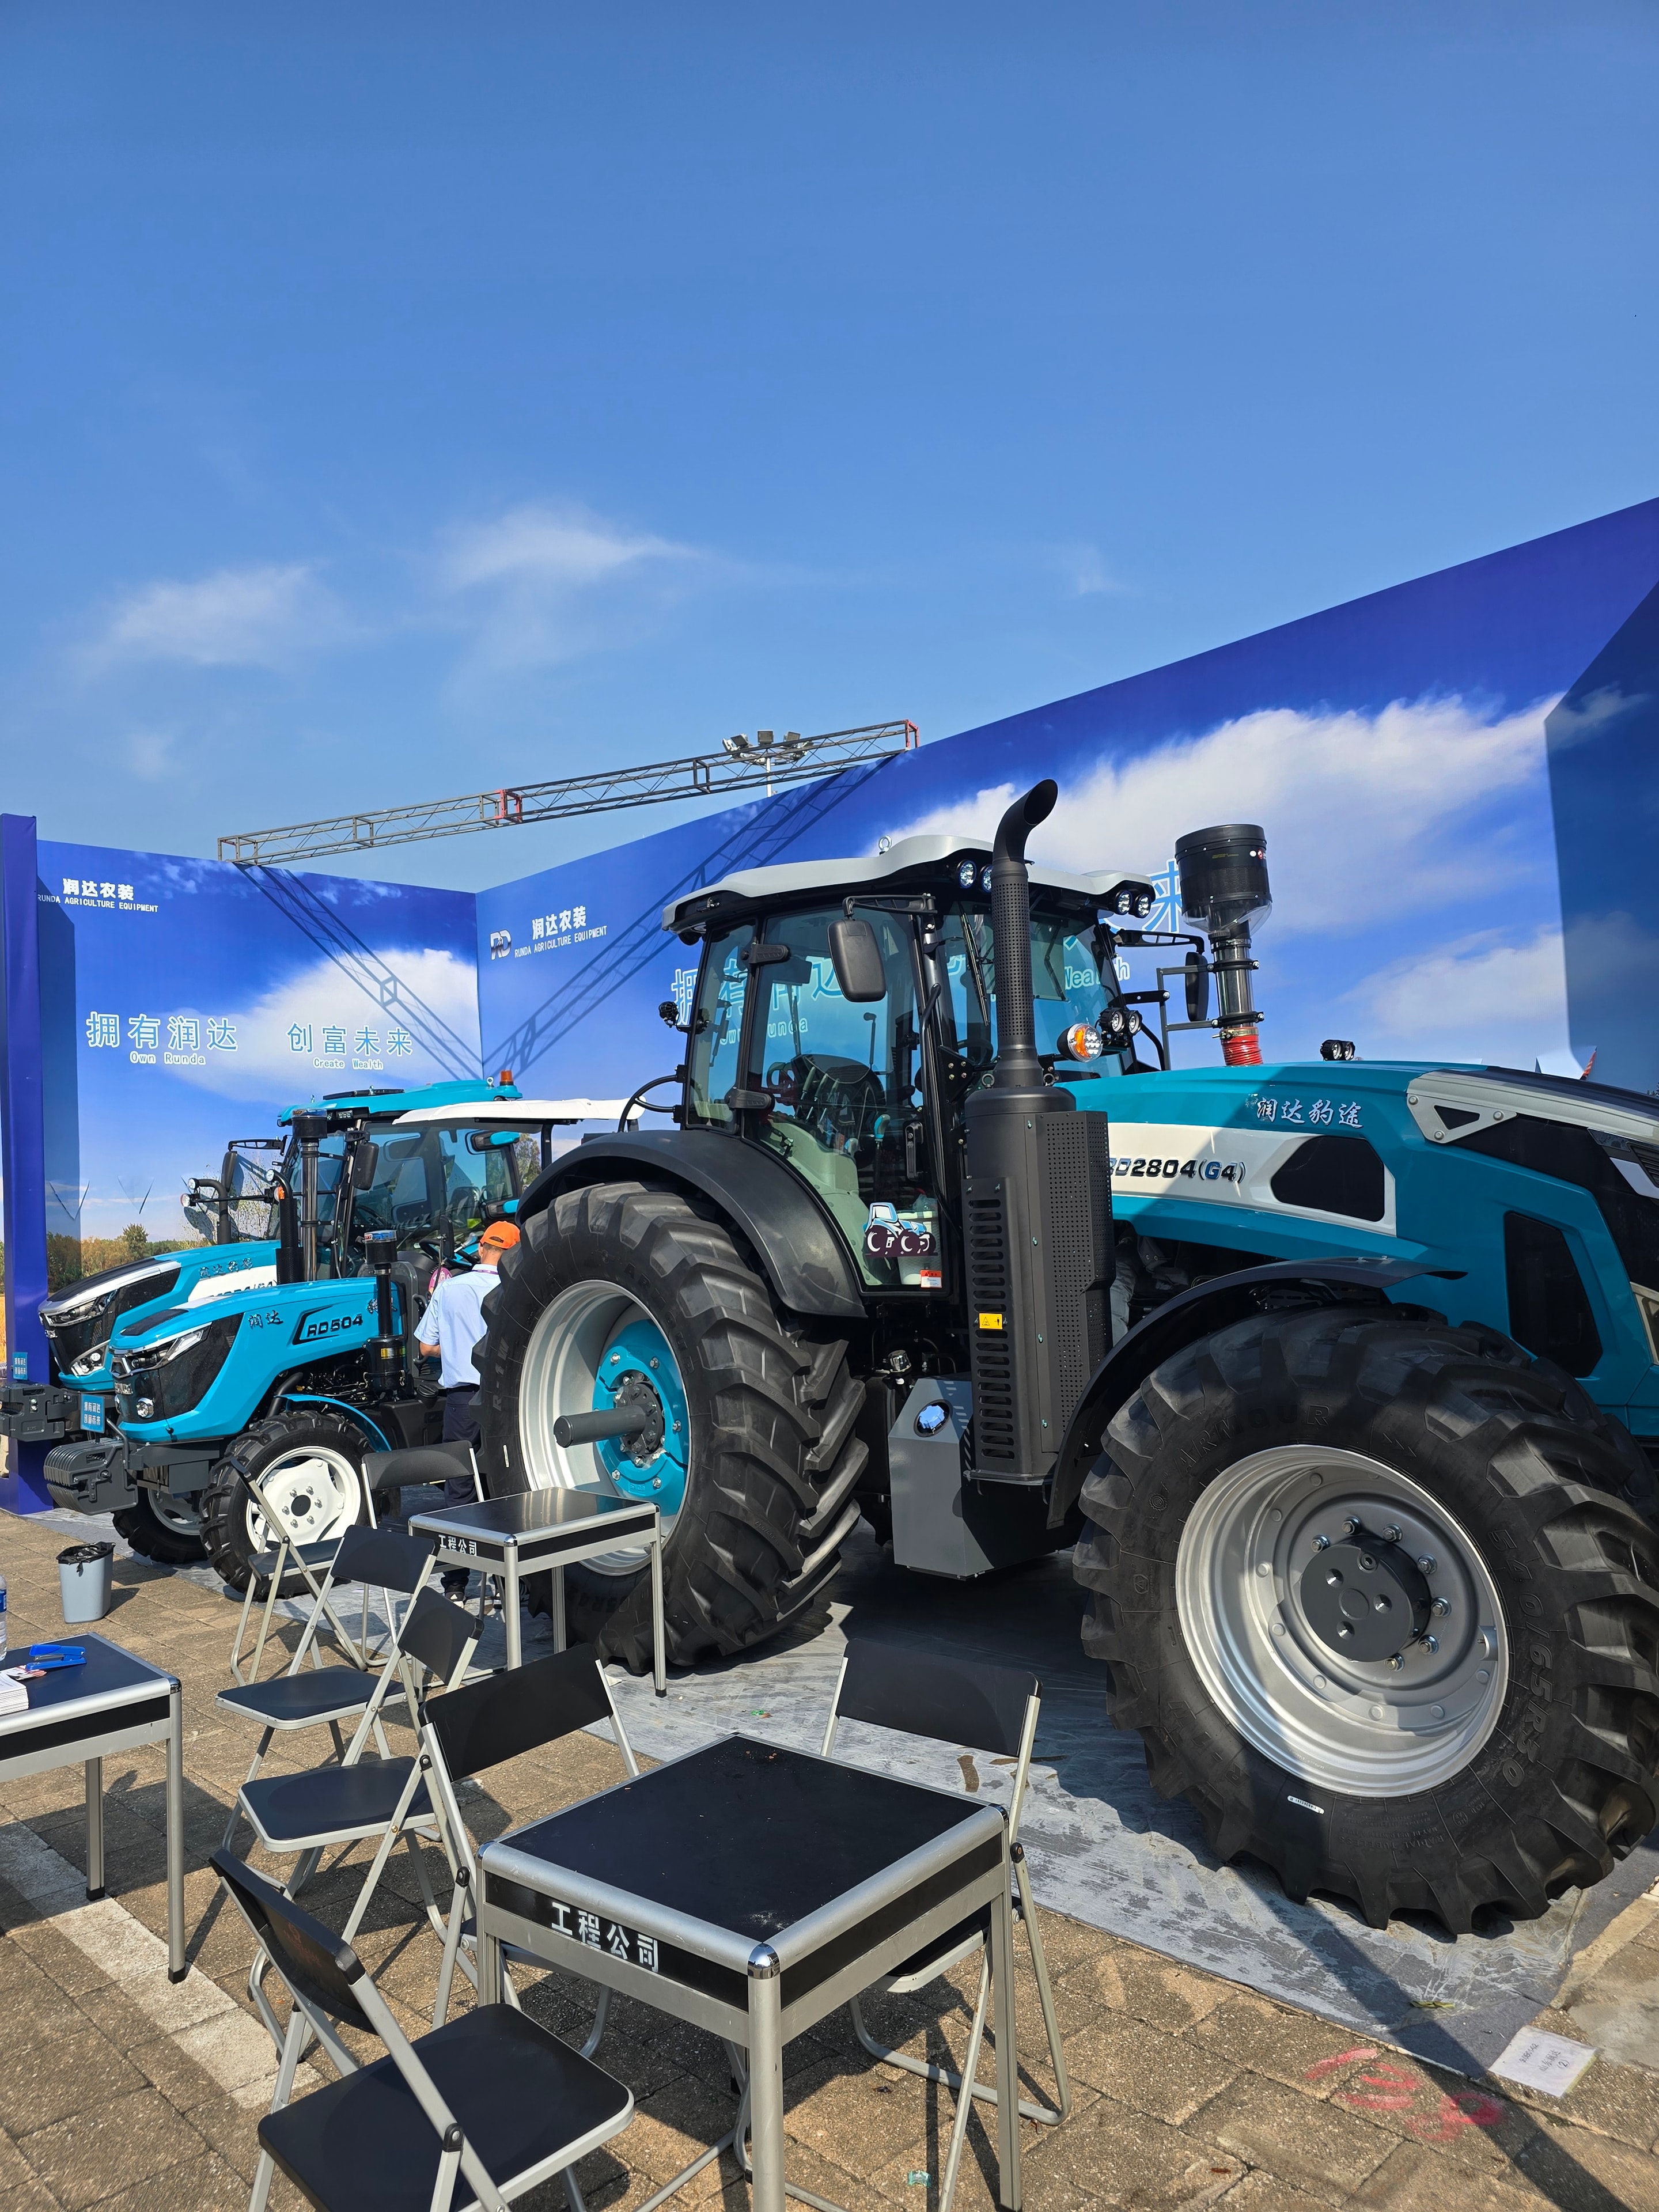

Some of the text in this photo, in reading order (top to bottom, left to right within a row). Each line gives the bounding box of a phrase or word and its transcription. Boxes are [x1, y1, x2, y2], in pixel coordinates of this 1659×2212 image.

[63, 878, 134, 900] 润达农装
[38, 893, 158, 912] RUNDA AGRICULTURE EQUIPMENT
[532, 905, 586, 940] 润达农装
[514, 925, 608, 959] RUNDA AGRICULTURE EQUIPMENT
[86, 1012, 413, 1056] 拥有润达 创富未来
[130, 1051, 206, 1065] Own Runda
[313, 1056, 384, 1070] Create Wealth
[1256, 1097, 1363, 1128] 润达豹途
[248, 1309, 283, 1330] 润达
[306, 1313, 364, 1338] RD504
[1173, 1403, 1332, 1479] ARMOUR
[438, 1534, 478, 1556] 工程公司
[551, 1902, 660, 1973] 工程公司
